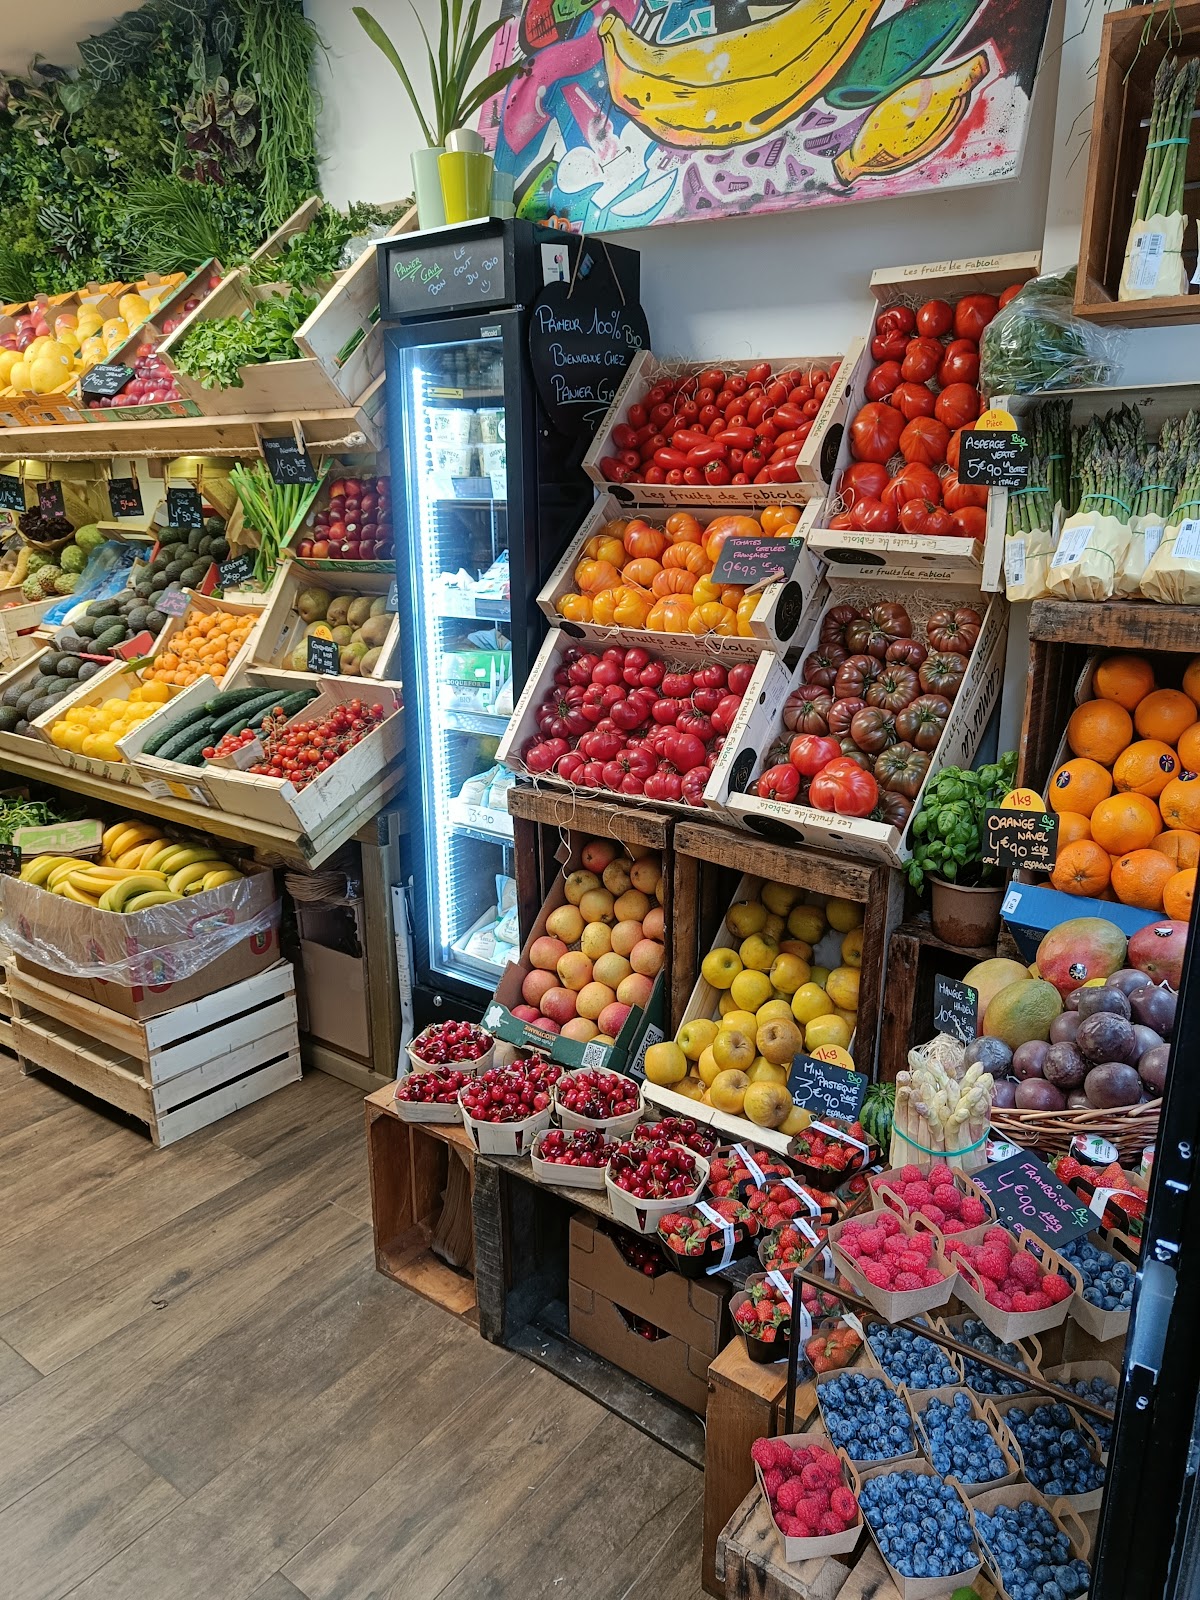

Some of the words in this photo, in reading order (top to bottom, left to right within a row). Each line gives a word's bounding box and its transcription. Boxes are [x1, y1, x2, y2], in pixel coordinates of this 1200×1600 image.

[454, 246, 466, 260] LE
[466, 271, 479, 285] DU
[428, 279, 446, 295] BON
[587, 308, 621, 340] 100%
[604, 350, 626, 366] CHEZ
[986, 420, 1003, 428] Pièce
[965, 437, 1006, 449] ASPERGE
[991, 450, 1017, 460] VERTE
[967, 458, 1002, 478] 5€90
[641, 490, 665, 499] Les
[670, 490, 712, 501] fruits
[716, 490, 738, 500] de
[743, 489, 804, 500] Fabiola
[722, 561, 757, 578] 9€95
[876, 567, 900, 576] fruits
[918, 570, 951, 578] Fabiola
[621, 633, 662, 644] fruits
[670, 637, 691, 648] de
[1011, 792, 1031, 806] 1kg
[760, 802, 791, 814] Fabiola
[794, 810, 805, 818] de
[809, 814, 834, 825] fruits
[837, 819, 853, 828] Les
[988, 815, 1036, 830] ORANGE
[1018, 832, 1048, 842] NAVEL
[989, 832, 1027, 857] 4€90
[1024, 861, 1055, 871] ESPAGNE
[816, 1048, 838, 1060] 1kg
[795, 1076, 839, 1108] 3€90
[997, 1170, 1037, 1216] 4€90
